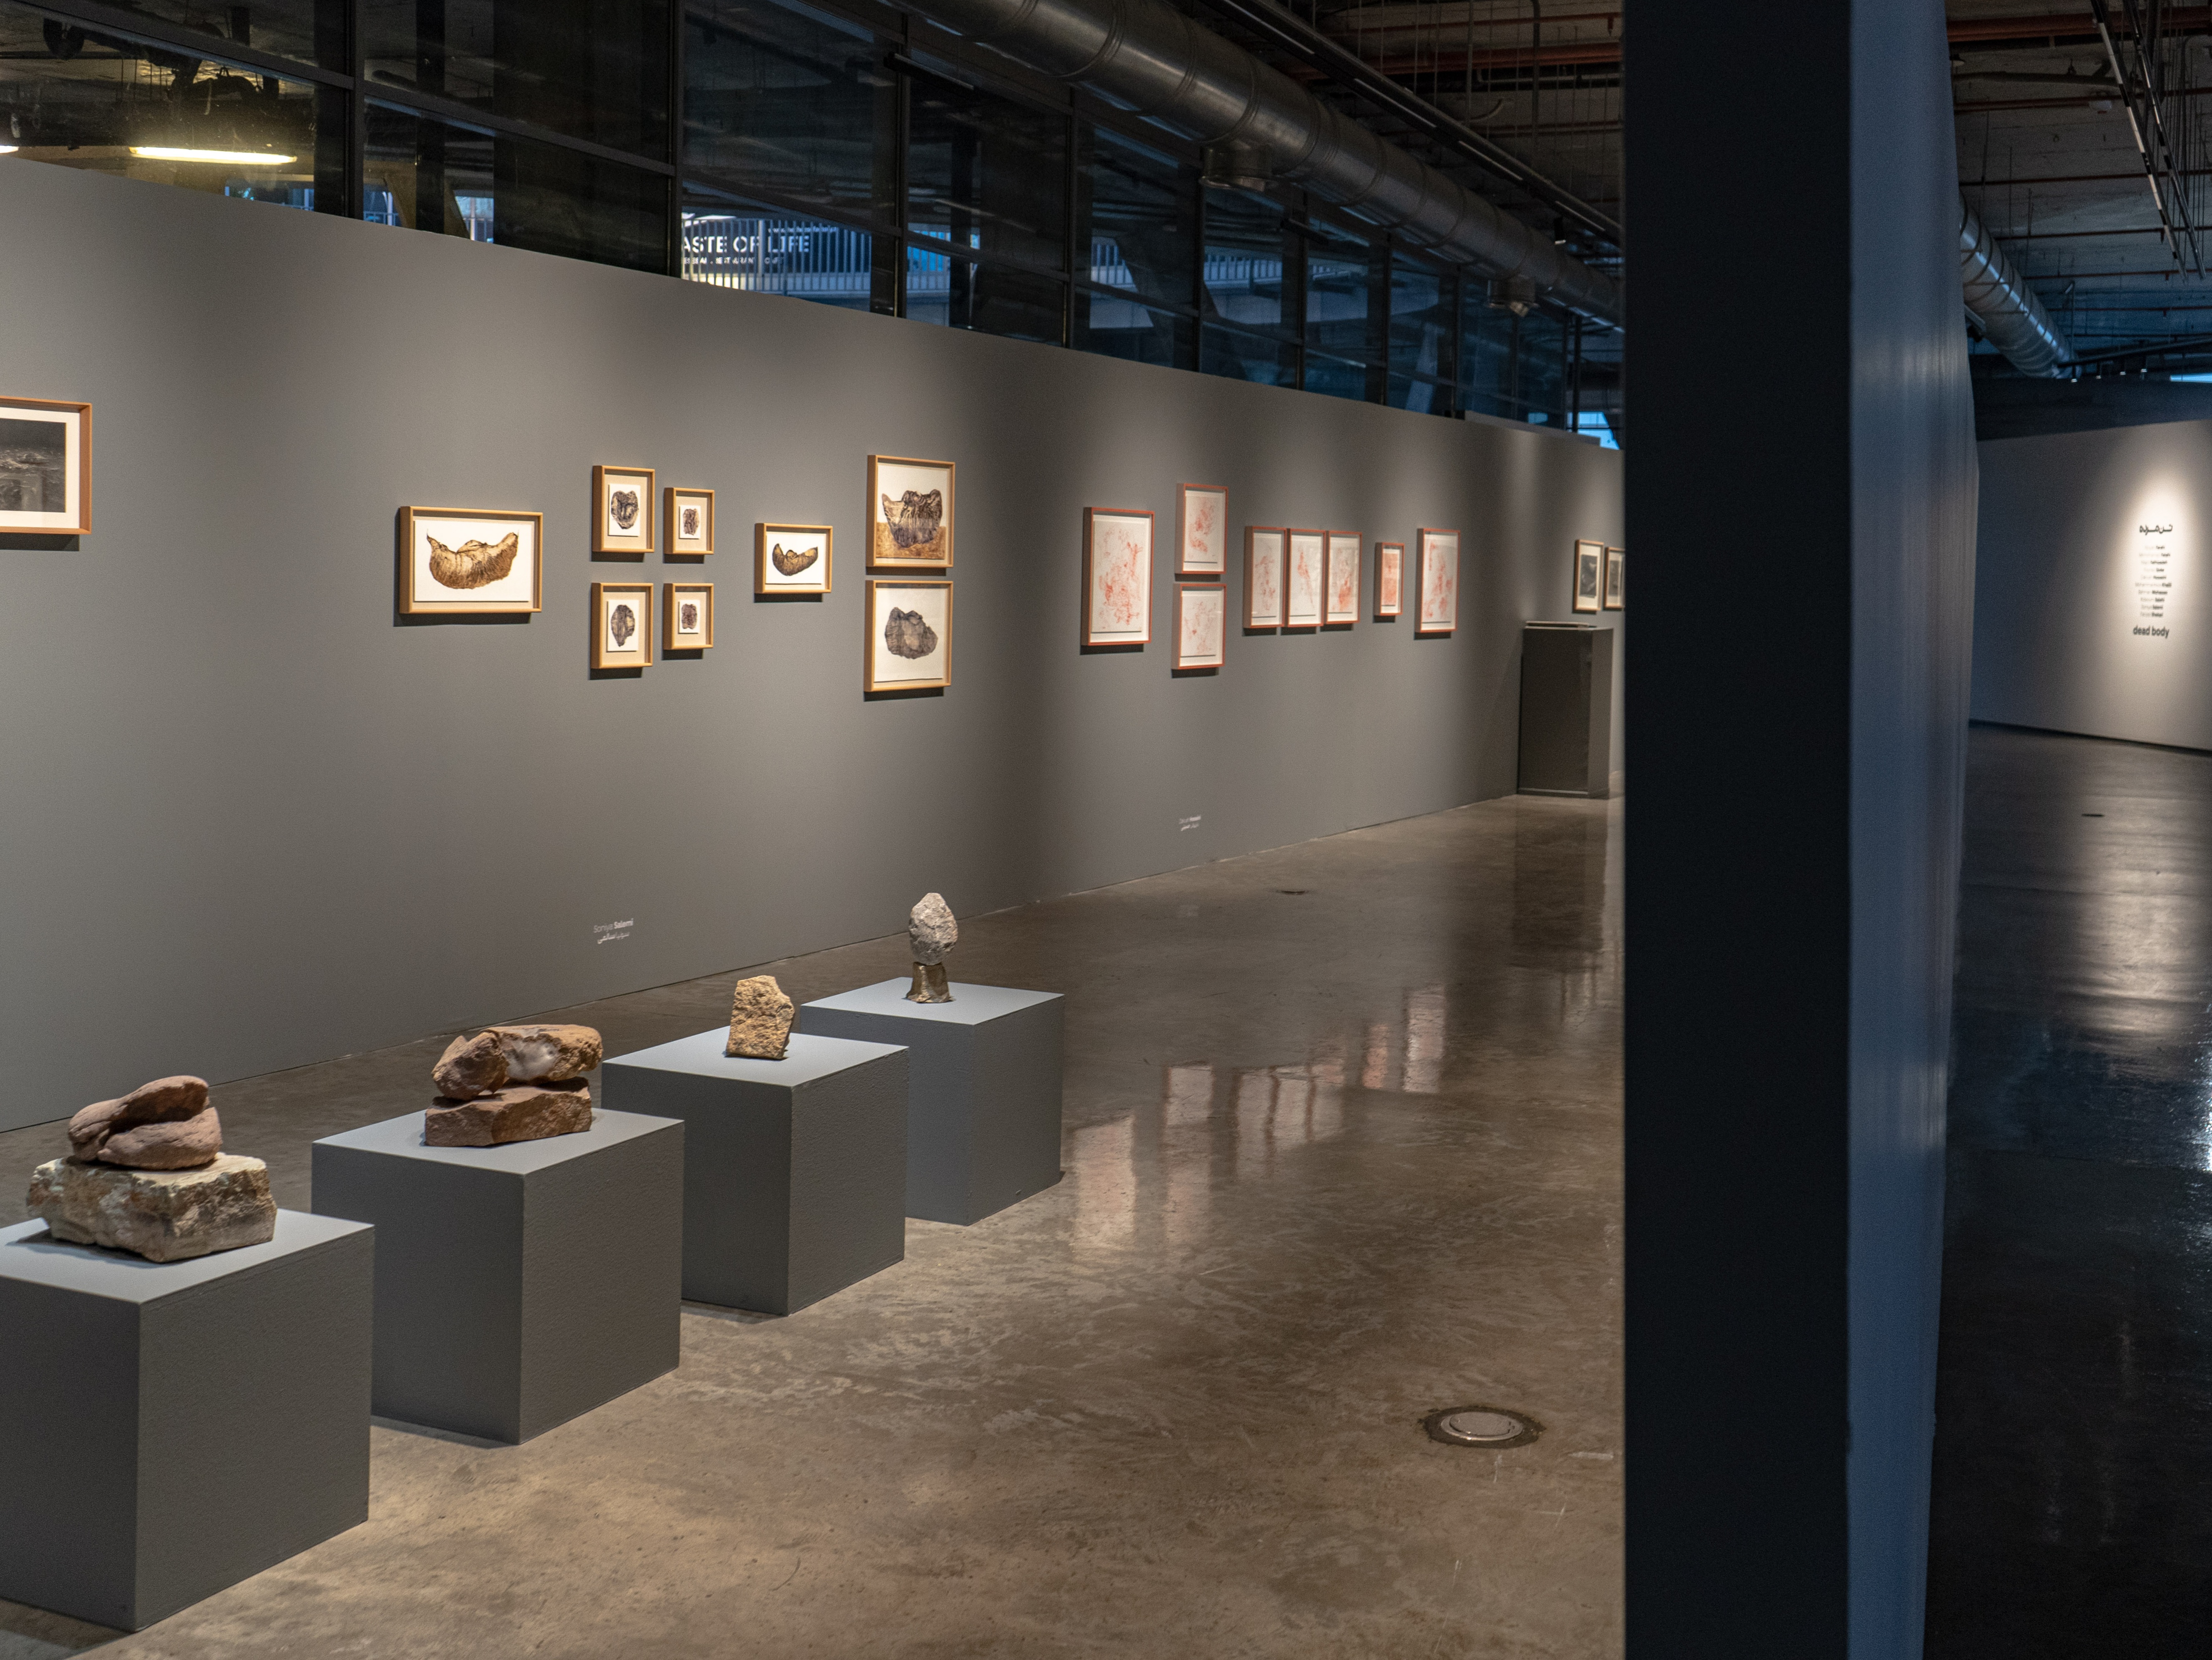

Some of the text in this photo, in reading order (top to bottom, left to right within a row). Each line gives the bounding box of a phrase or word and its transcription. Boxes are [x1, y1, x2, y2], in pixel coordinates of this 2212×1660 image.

[733, 236, 760, 253] OF
[768, 236, 810, 253] LIFE
[2133, 625, 2170, 639] dead body
